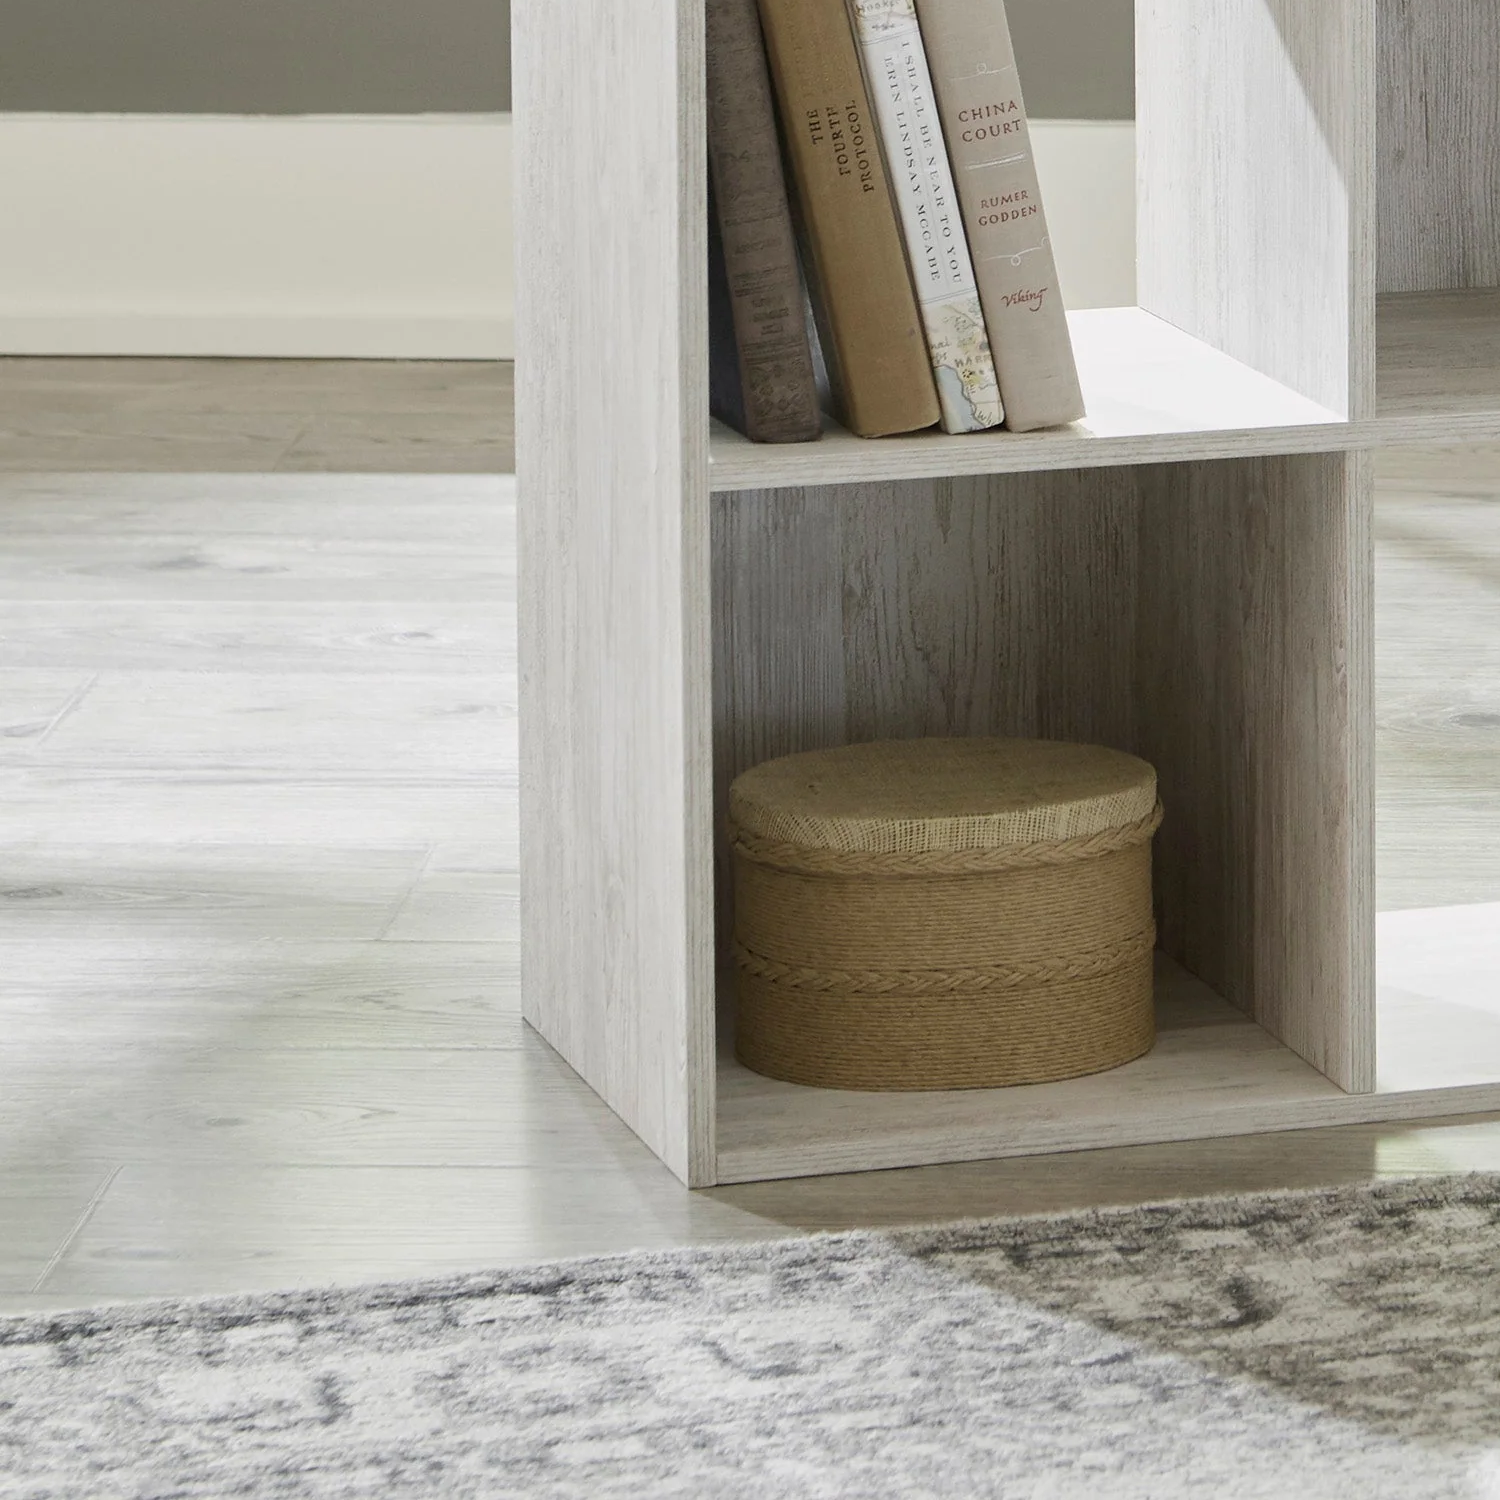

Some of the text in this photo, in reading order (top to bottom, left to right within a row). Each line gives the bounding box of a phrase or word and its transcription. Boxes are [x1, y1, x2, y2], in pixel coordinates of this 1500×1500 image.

[883, 56, 902, 103] ERIN
[896, 111, 922, 196] LINDSAY
[958, 100, 1018, 122] CHINA
[807, 109, 824, 145] THE
[825, 107, 851, 176] FOURTH
[962, 119, 1021, 143] COURT
[845, 100, 875, 192] PROTOCOL
[904, 54, 925, 118] SHALL
[919, 124, 931, 149] BE
[925, 155, 944, 207] NEAR
[939, 214, 951, 238] TO
[945, 245, 961, 284] YOU
[980, 190, 1029, 209] RUMER
[978, 205, 1038, 226] GODDEN
[1001, 287, 1048, 312] Viking
